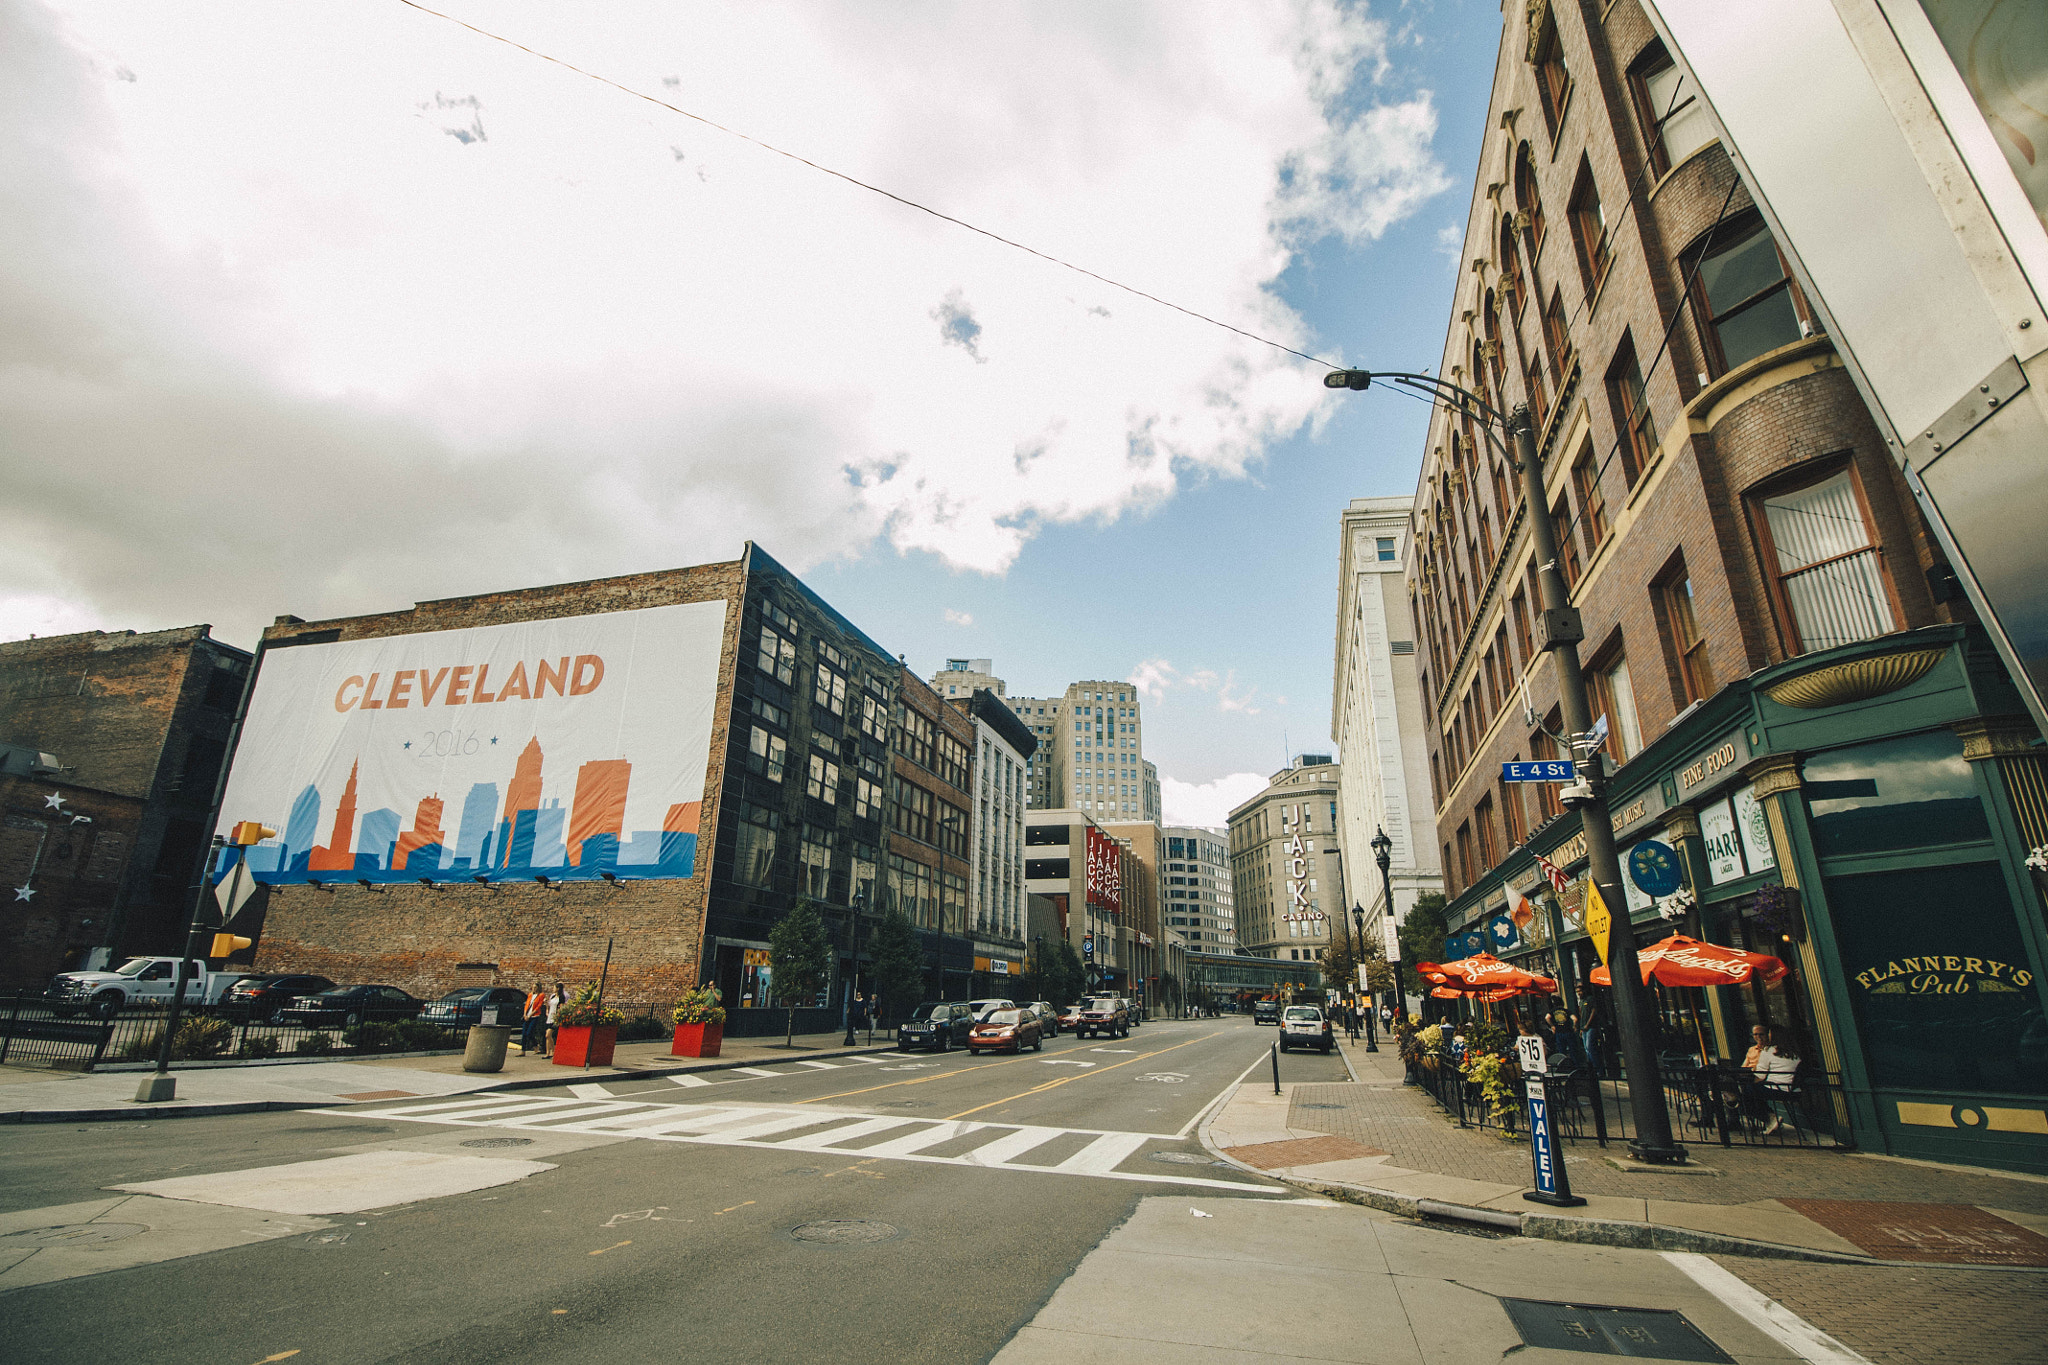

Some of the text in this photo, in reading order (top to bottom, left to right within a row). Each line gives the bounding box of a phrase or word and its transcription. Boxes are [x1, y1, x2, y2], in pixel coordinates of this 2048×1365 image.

[335, 654, 605, 713] CLEVELAND
[418, 729, 480, 758] 2016
[1510, 763, 1566, 777] E. 4 St
[1682, 743, 1735, 789] FINE FOOD
[1623, 800, 1646, 825] MUSIC
[1087, 836, 1096, 891] JACK
[1096, 843, 1104, 896] JACK
[1104, 848, 1112, 899] JACK
[1291, 804, 1310, 906] JACK
[1720, 863, 1734, 875] LAGER
[1111, 854, 1119, 903] JACK
[1281, 911, 1324, 922] CASINO
[1855, 955, 2033, 989] FLANNERY'S
[1909, 974, 1971, 995] Pub
[1520, 1038, 1540, 1060] $15
[1533, 1103, 1552, 1188] VALET
